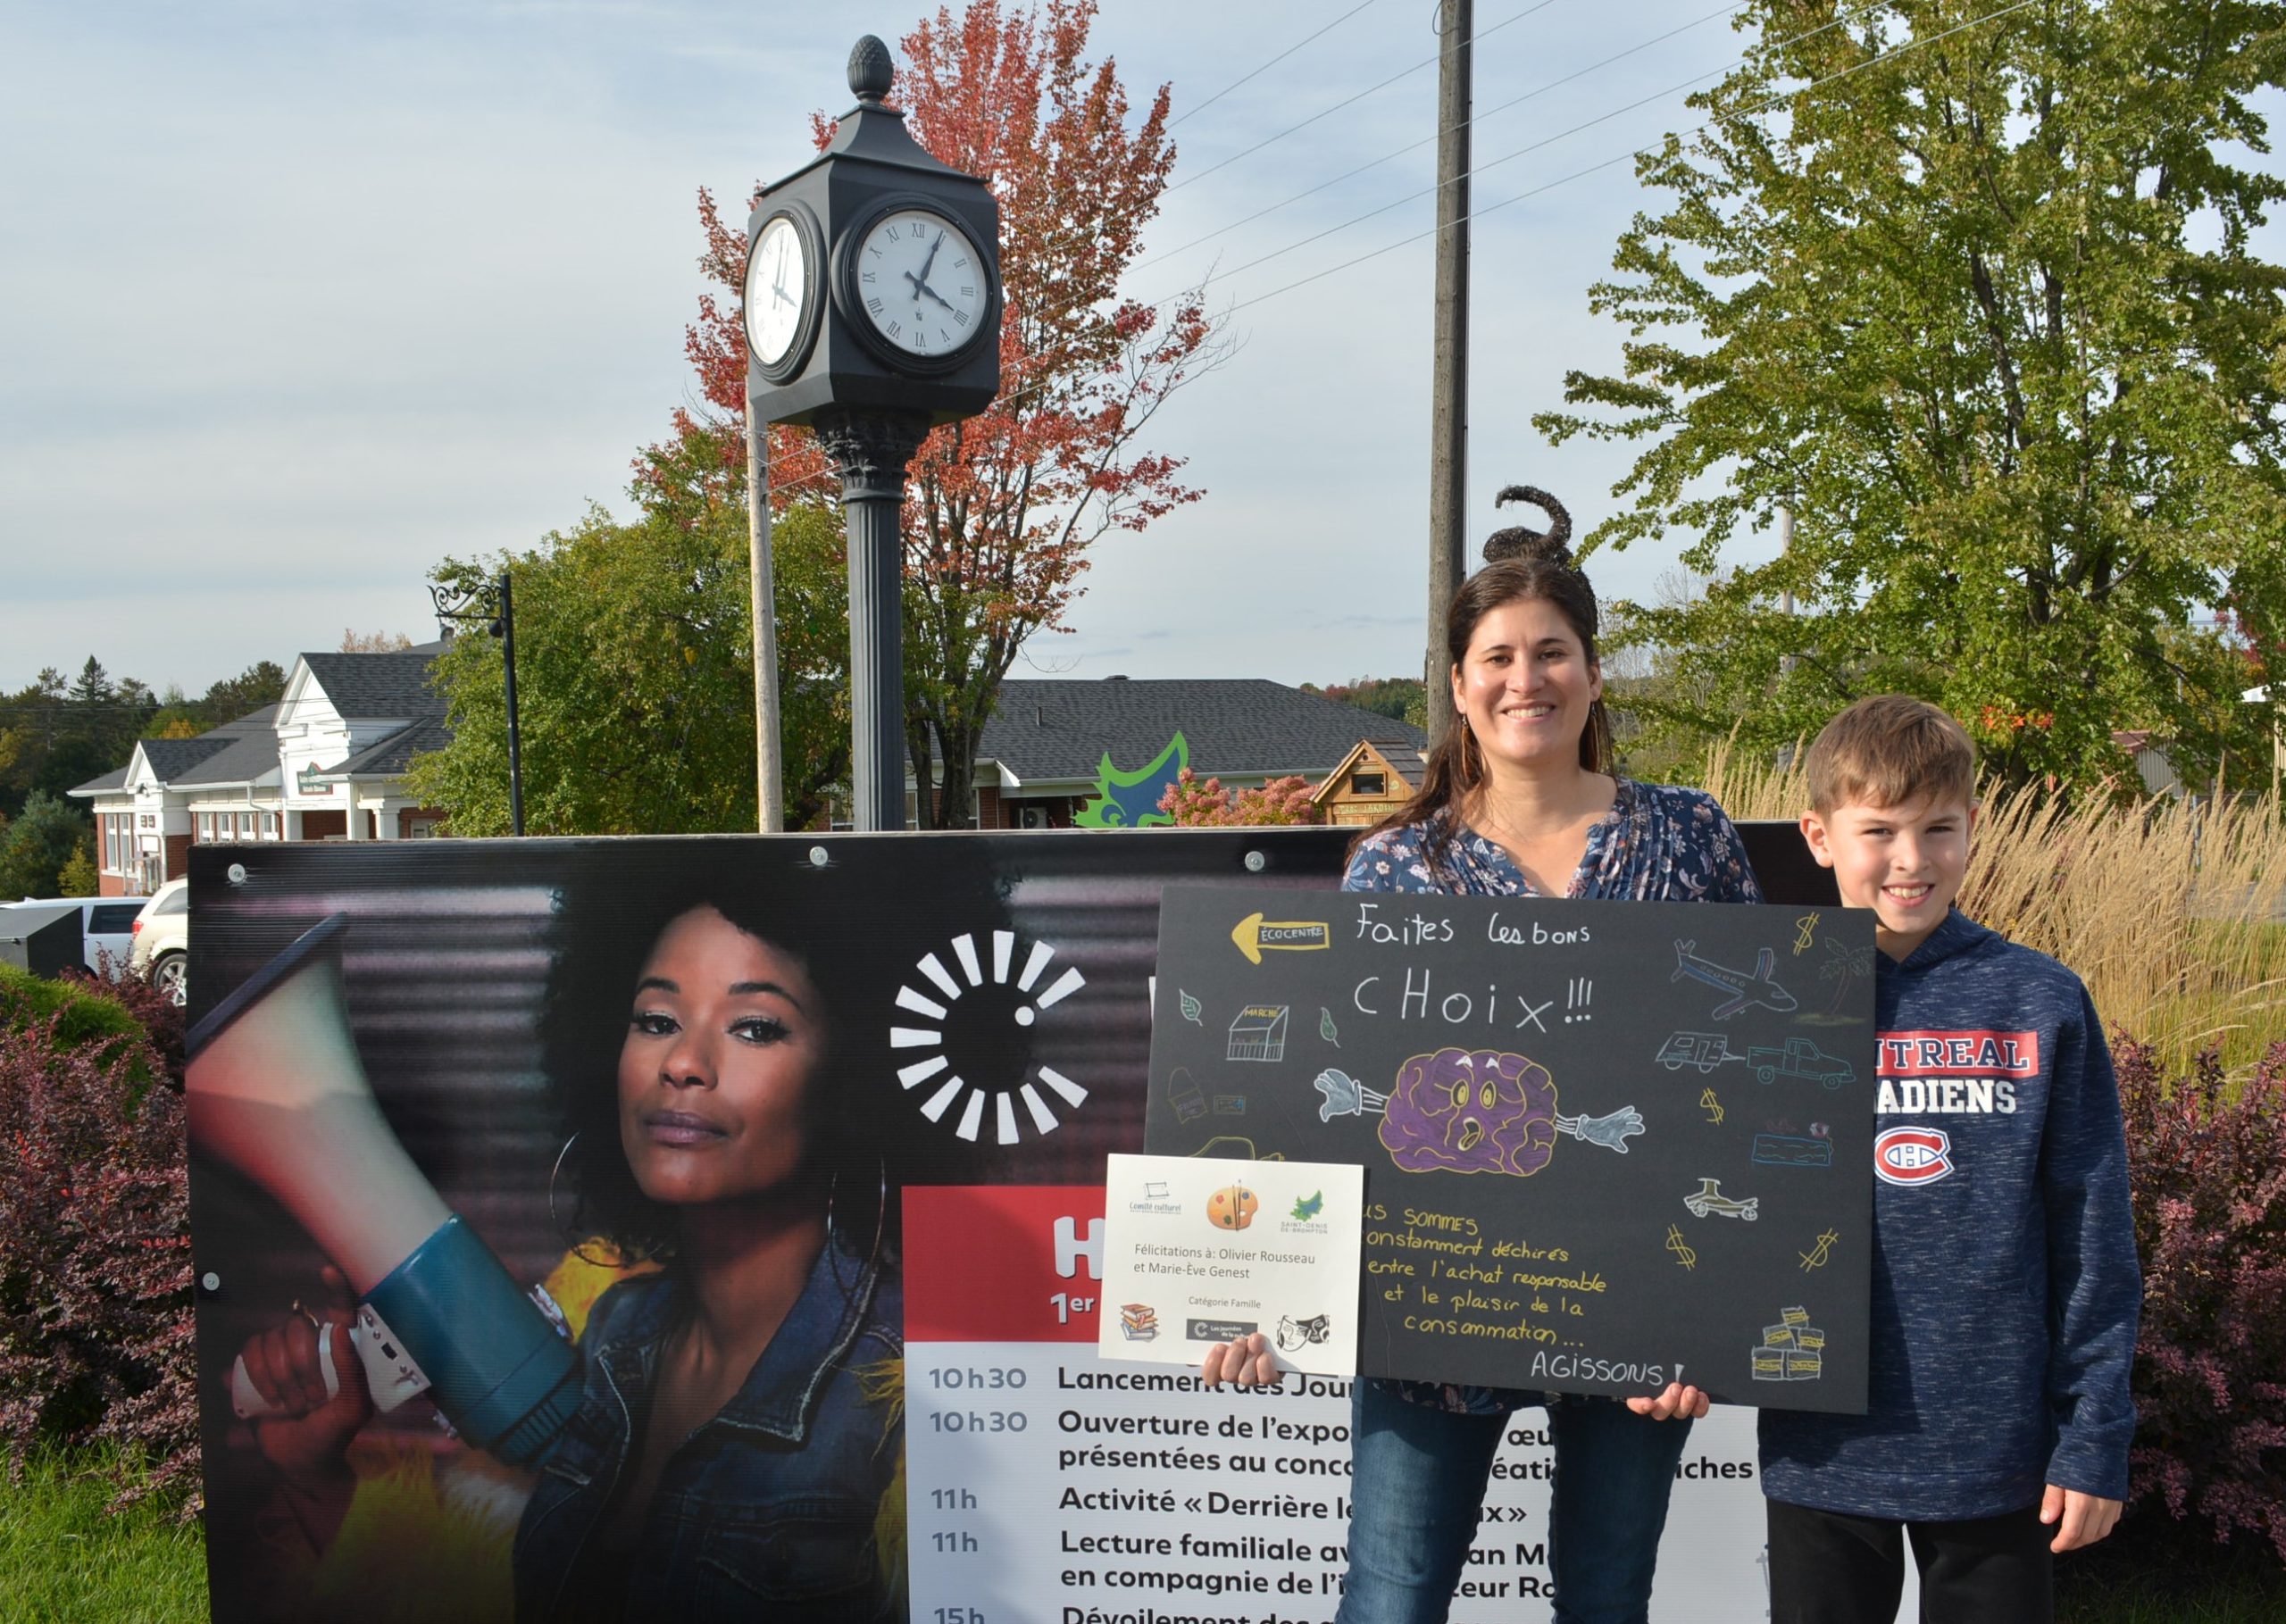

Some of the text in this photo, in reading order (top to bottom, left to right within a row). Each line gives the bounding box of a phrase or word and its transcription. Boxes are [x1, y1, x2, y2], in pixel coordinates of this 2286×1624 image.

[1261, 927, 1323, 942] ÉCOCENTRE
[1356, 904, 1454, 945] Faites
[1488, 912, 1524, 945] les
[1134, 1244, 1202, 1259] Félicitations
[1219, 1248, 1256, 1262] Olivier
[1261, 1251, 1315, 1264] Rousseau
[1492, 1240, 1569, 1262] déchirés
[1134, 1262, 1250, 1278] et Marie-Ève Genest
[1368, 1259, 1415, 1276] entre
[1431, 1260, 1504, 1283] l'achat
[1050, 1292, 1095, 1324] 1er
[1189, 1296, 1261, 1310] Catégorie Famille
[1384, 1284, 1584, 1316] et le plaisir de la
[1058, 1410, 1209, 1437] Ouverture
[1218, 1415, 1253, 1438] de
[1059, 1444, 1221, 1470] présentées
[1229, 1455, 1265, 1472] au
[1059, 1487, 1175, 1512] Activité
[1062, 1530, 1172, 1554] Lecture
[1180, 1534, 1311, 1562] familiale
[1061, 1569, 1096, 1587] en
[1105, 1570, 1268, 1595] compagnie
[1277, 1572, 1313, 1595] de
